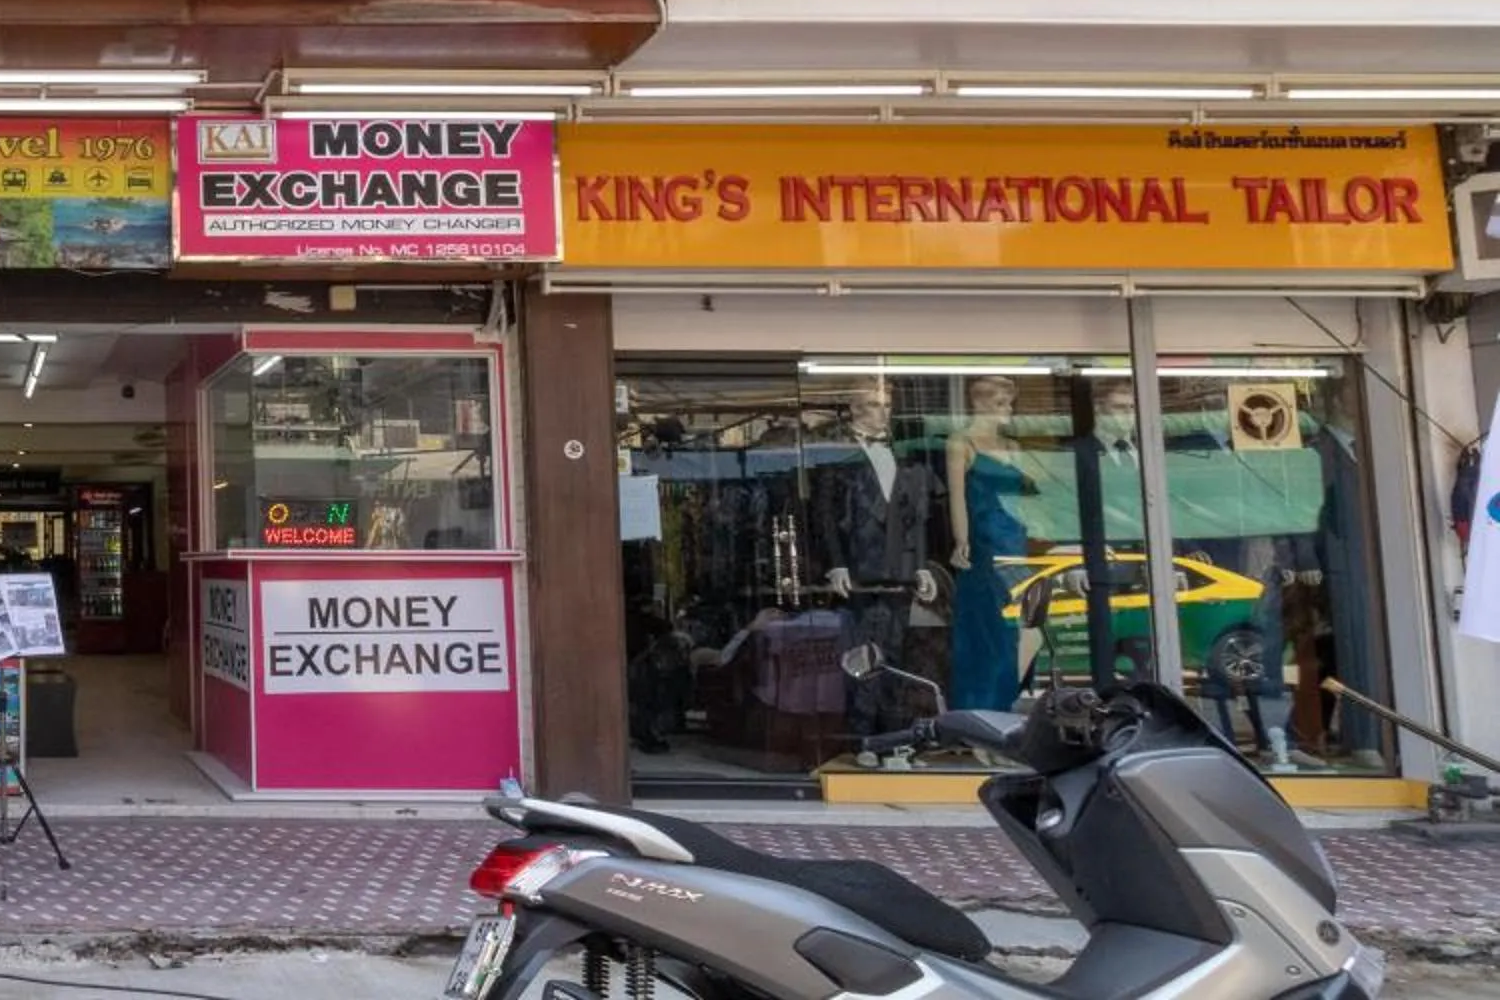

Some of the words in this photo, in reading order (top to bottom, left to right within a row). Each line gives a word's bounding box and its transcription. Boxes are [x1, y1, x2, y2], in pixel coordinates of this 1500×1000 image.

[79, 135, 154, 160] 1976
[206, 125, 269, 153] KAI
[311, 121, 522, 158] MONEY
[202, 172, 522, 208] EXCHANGE
[574, 170, 751, 222] KING'S
[778, 175, 1210, 224] INTERNATIONAL
[1231, 175, 1423, 224] TAILOR
[208, 217, 335, 231] AUTHORIZED
[341, 217, 415, 231] MONEY
[423, 217, 521, 231] CHANGER
[391, 243, 420, 255] MC
[268, 503, 350, 524] ON
[265, 527, 355, 544] WELCOME
[309, 596, 457, 628] MONEY
[269, 642, 503, 677] EXCHANGE
